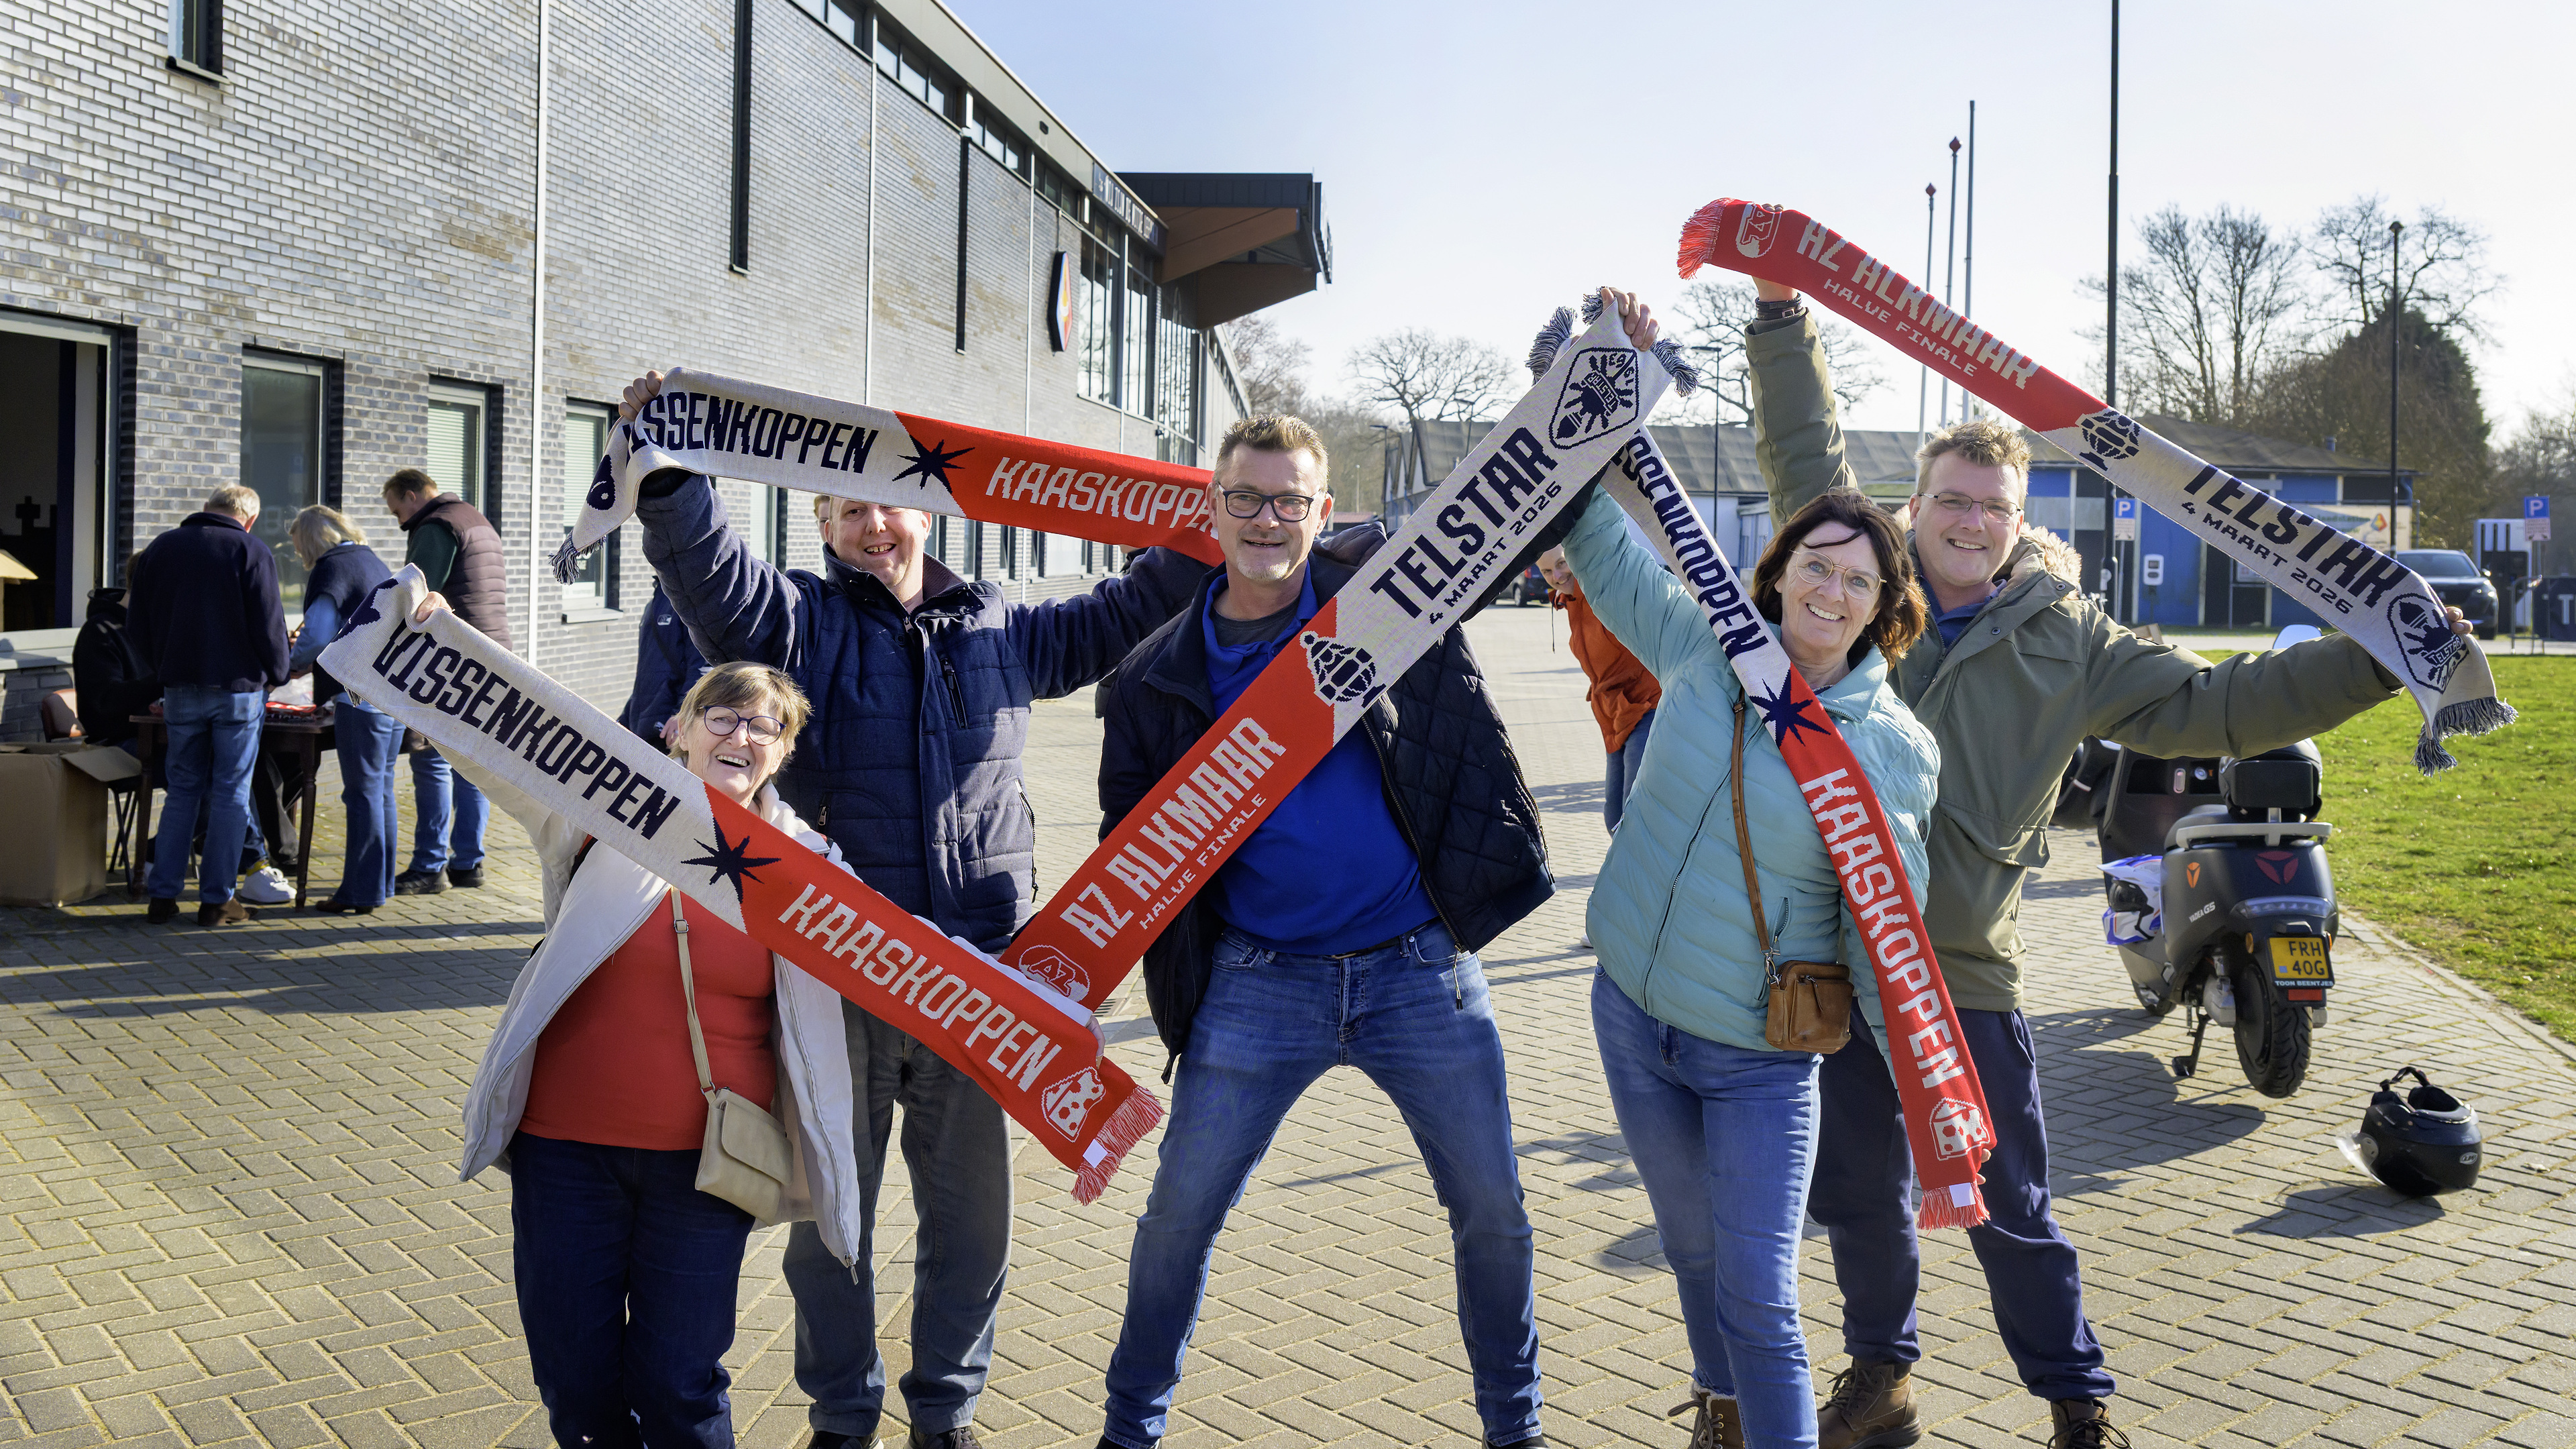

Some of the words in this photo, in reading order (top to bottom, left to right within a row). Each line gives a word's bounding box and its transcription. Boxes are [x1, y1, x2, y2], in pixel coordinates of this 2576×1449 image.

[1796, 219, 1847, 272] AZ
[1851, 251, 2041, 390] ALKMAAR
[1823, 278, 1890, 323] HALVE
[1896, 322, 1978, 377] FINALE
[623, 392, 877, 474] ISSENKOPPEN
[1587, 373, 1617, 410] TELSTAR
[1370, 427, 1558, 619] TELSTAR
[1430, 611, 1444, 625] 4
[1443, 538, 1507, 608] MAART
[1509, 480, 1561, 536] 2026
[2118, 501, 2131, 517] P
[2182, 501, 2196, 515] 4
[2202, 513, 2288, 567] MAART
[2291, 566, 2355, 615] 2026
[2184, 464, 2412, 609] TELSTAR
[2530, 500, 2544, 516] P
[2428, 637, 2461, 663] TELSTAR
[372, 618, 681, 840] VISSENKOPPEN
[777, 883, 1062, 1092] KAASKOPPEN
[1060, 881, 1134, 949] AZ
[1105, 717, 1286, 901] ALKMAAR
[1140, 868, 1195, 930] HALVE
[1197, 794, 1267, 867] FINALE
[1800, 767, 1965, 1089] KAASKOPPEN
[2189, 909, 2204, 922] YADEA
[2288, 941, 2322, 957] FRH
[2292, 960, 2325, 975] 40G
